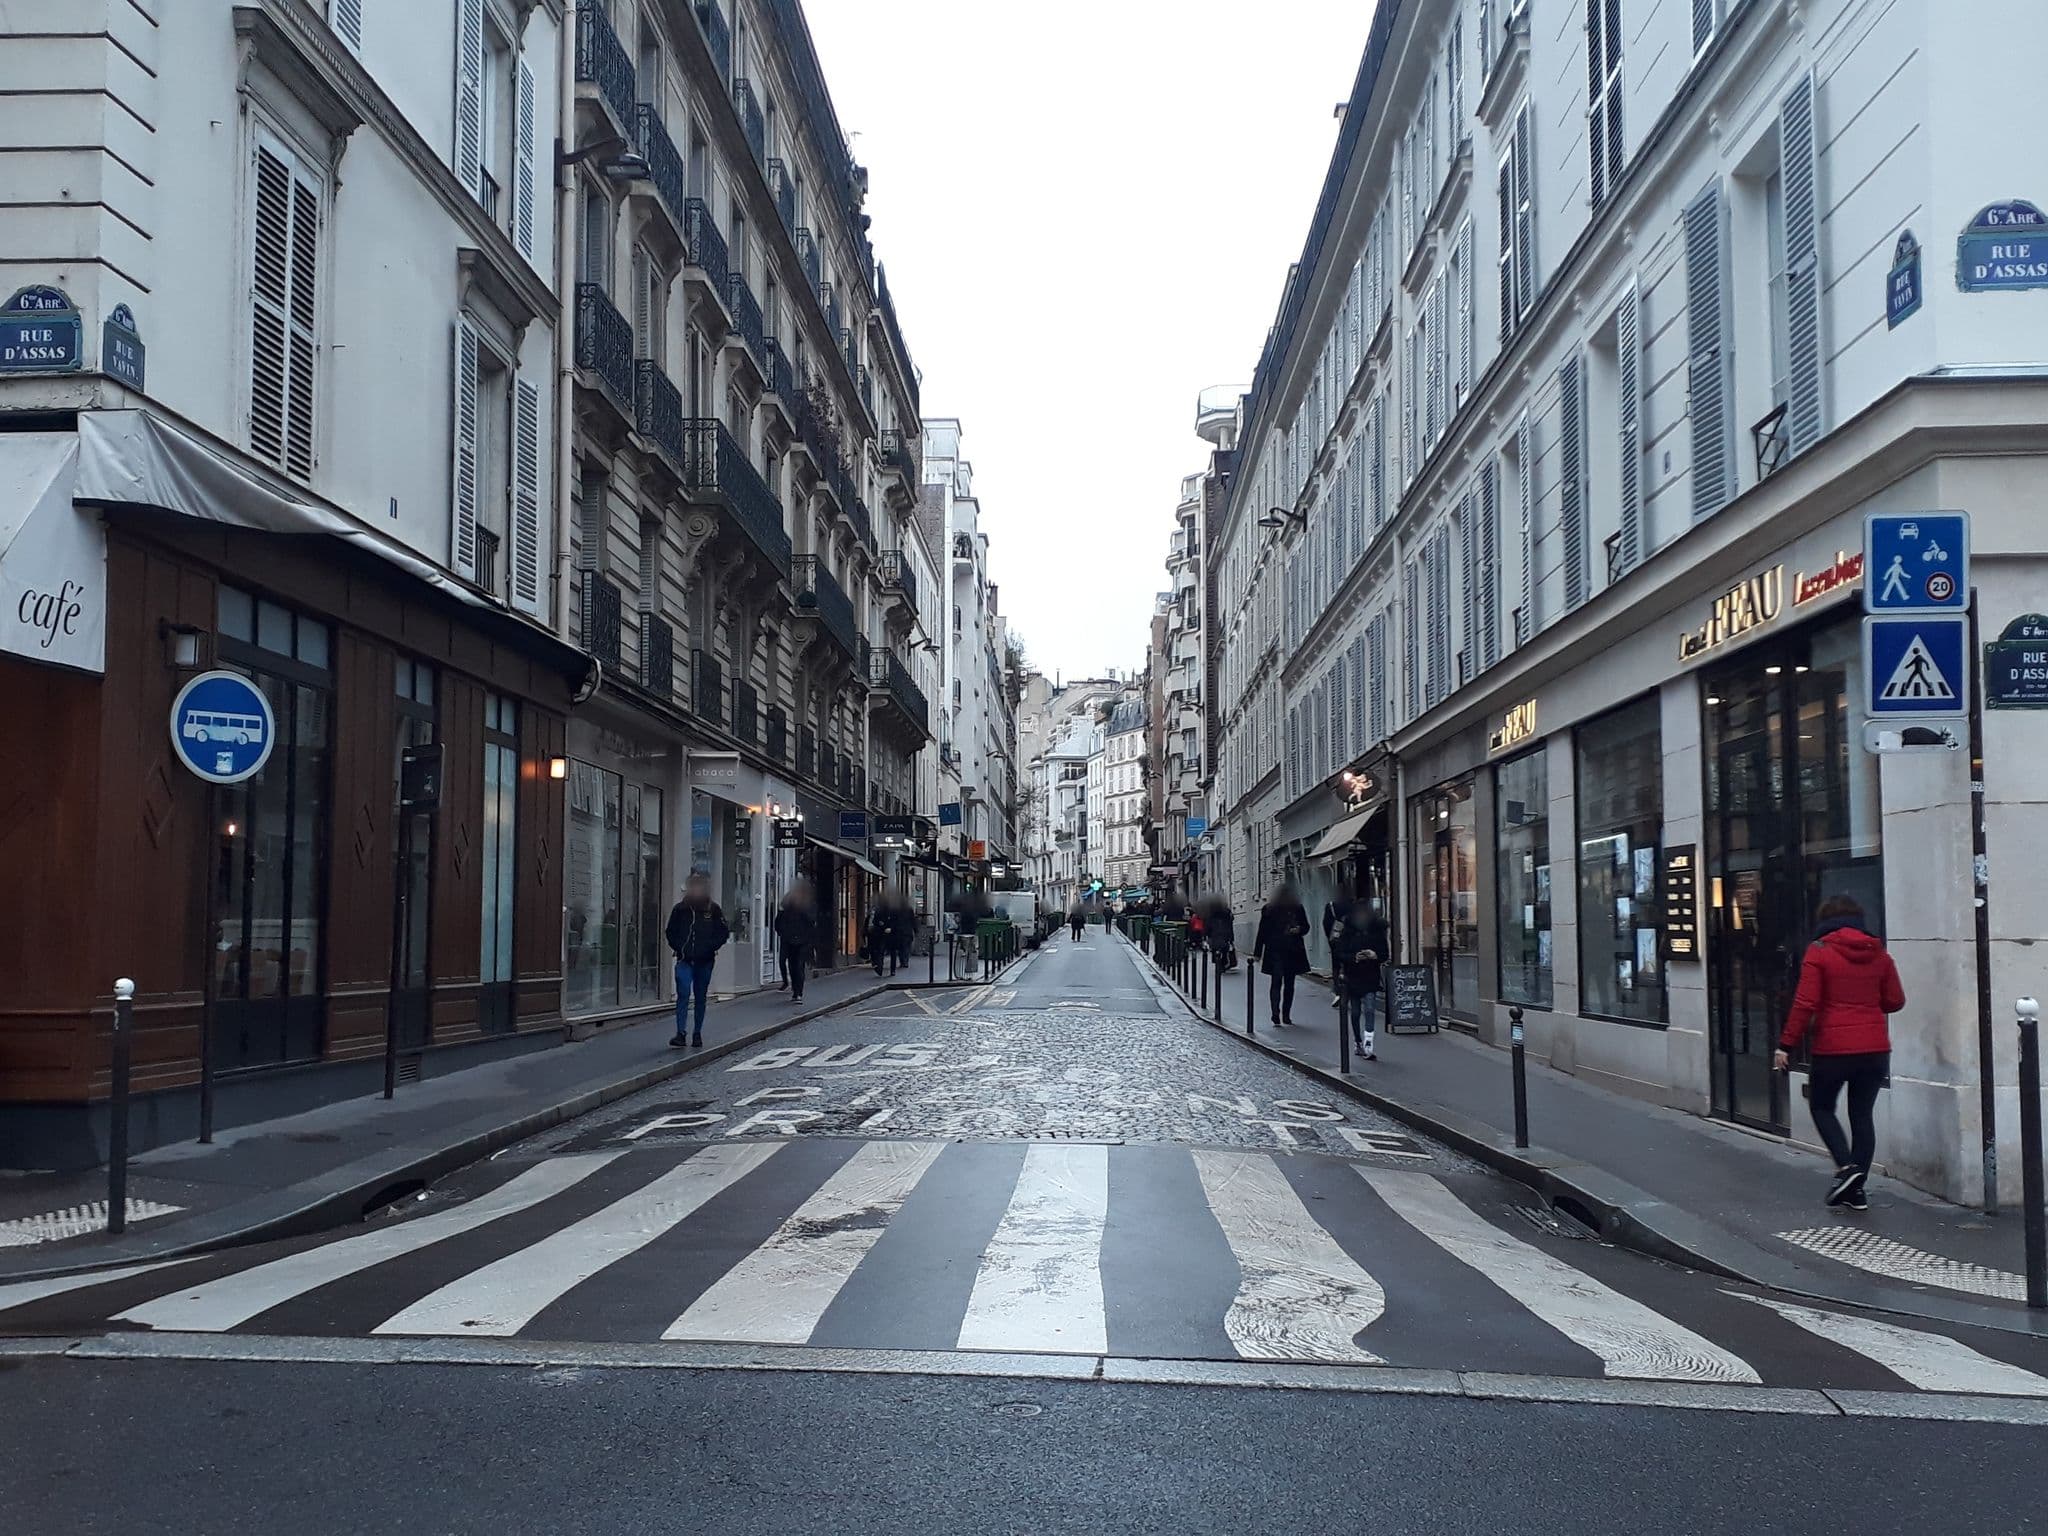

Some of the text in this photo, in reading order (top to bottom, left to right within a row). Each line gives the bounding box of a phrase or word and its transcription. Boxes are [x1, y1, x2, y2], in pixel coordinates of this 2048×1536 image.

[1992, 244, 2030, 259] RUE
[1975, 262, 2047, 279] D'ASSAS
[20, 329, 53, 342] RUE
[5, 346, 66, 359] D'ASSAS
[1932, 580, 1949, 592] 20
[18, 580, 85, 649] café
[2023, 652, 2047, 664] RUE
[725, 1042, 944, 1072] BUS
